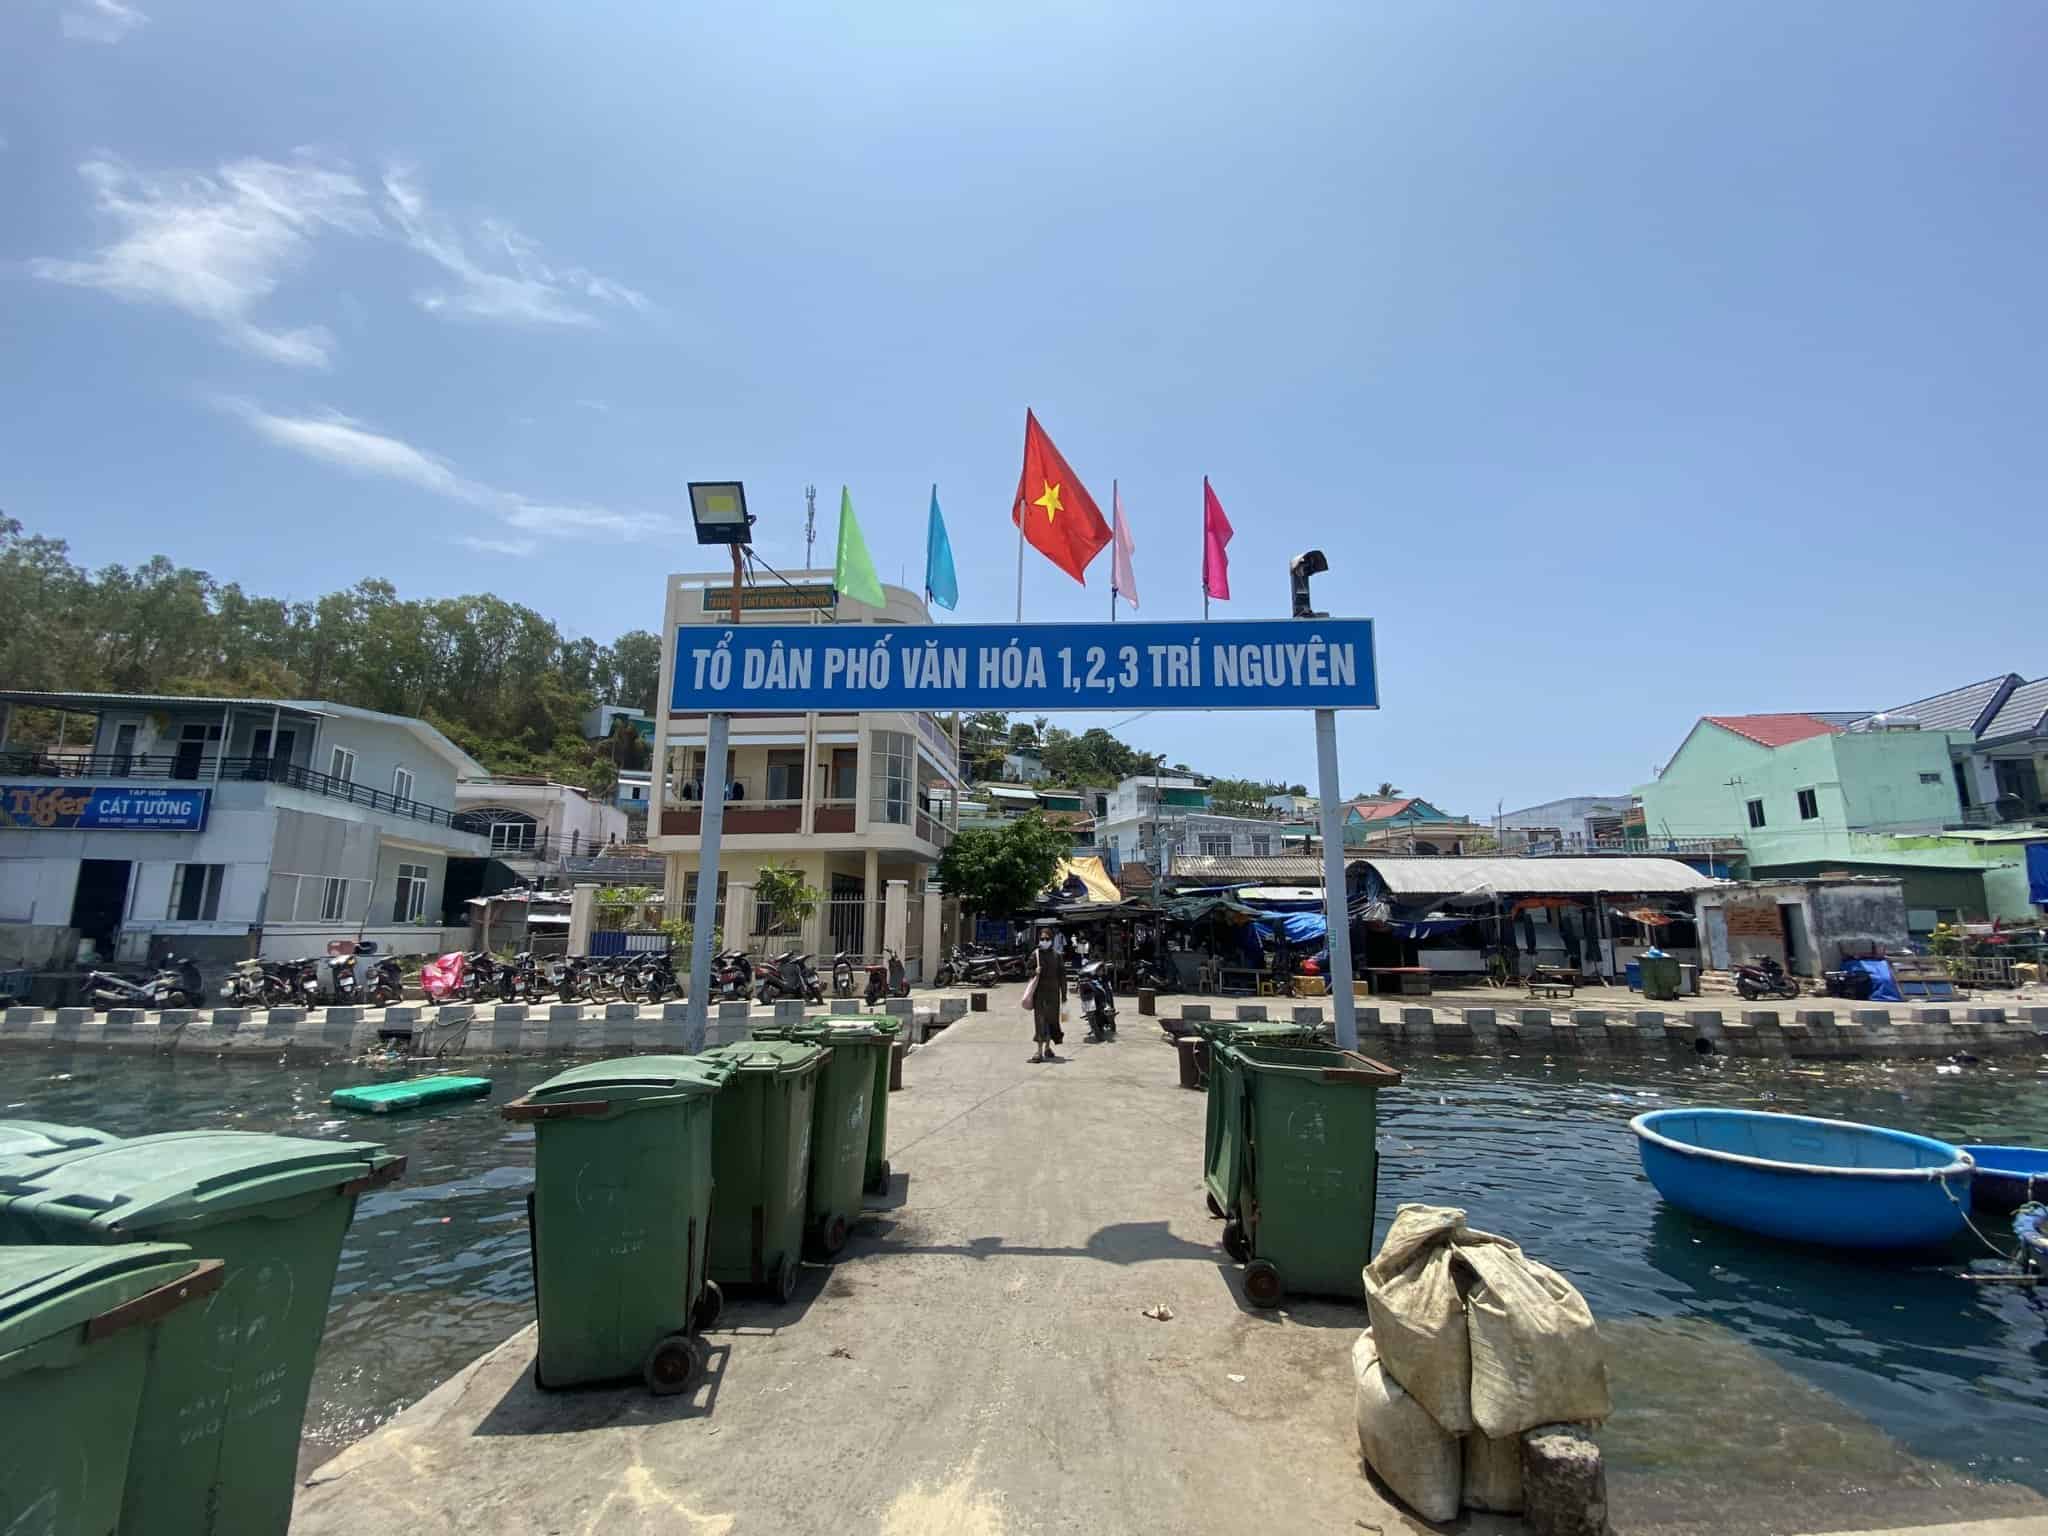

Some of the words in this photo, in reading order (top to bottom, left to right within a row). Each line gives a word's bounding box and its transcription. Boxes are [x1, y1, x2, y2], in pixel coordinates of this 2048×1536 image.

[692, 631, 733, 690] TỔ
[743, 639, 812, 690] DÂN
[824, 633, 893, 690] PHỐ
[902, 639, 967, 689] VĂN
[978, 637, 1047, 689] HÓA
[1058, 645, 1139, 693] 1,2,3
[1148, 636, 1201, 688] TRÍ
[1213, 634, 1356, 688] NGUYÊN
[10, 787, 91, 826] Tiger
[99, 796, 129, 814] CÁT
[136, 797, 192, 815] TƯỜNG
